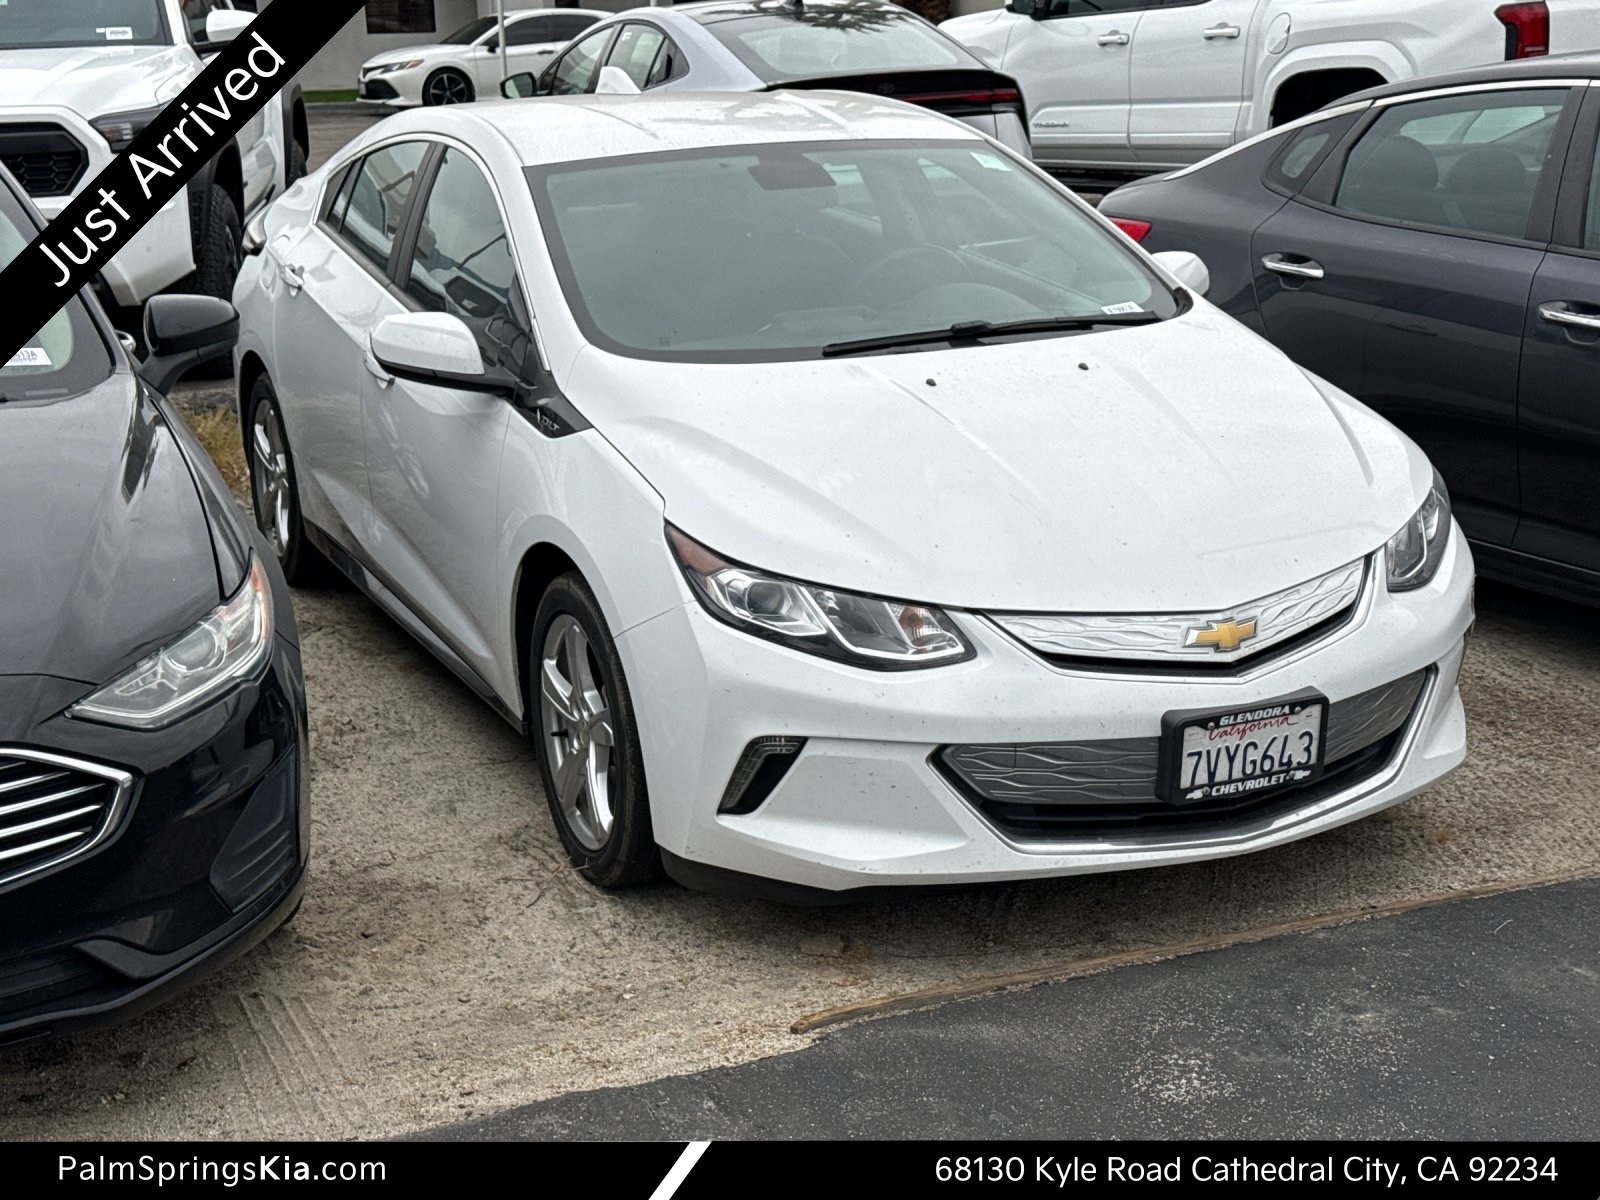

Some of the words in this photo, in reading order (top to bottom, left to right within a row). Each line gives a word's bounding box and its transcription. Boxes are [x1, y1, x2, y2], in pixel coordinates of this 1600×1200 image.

[1219, 704, 1290, 727] GLENDORA
[1208, 716, 1299, 742] California
[1186, 730, 1314, 788] 7VYG643
[1211, 773, 1288, 797] CHEVROLET
